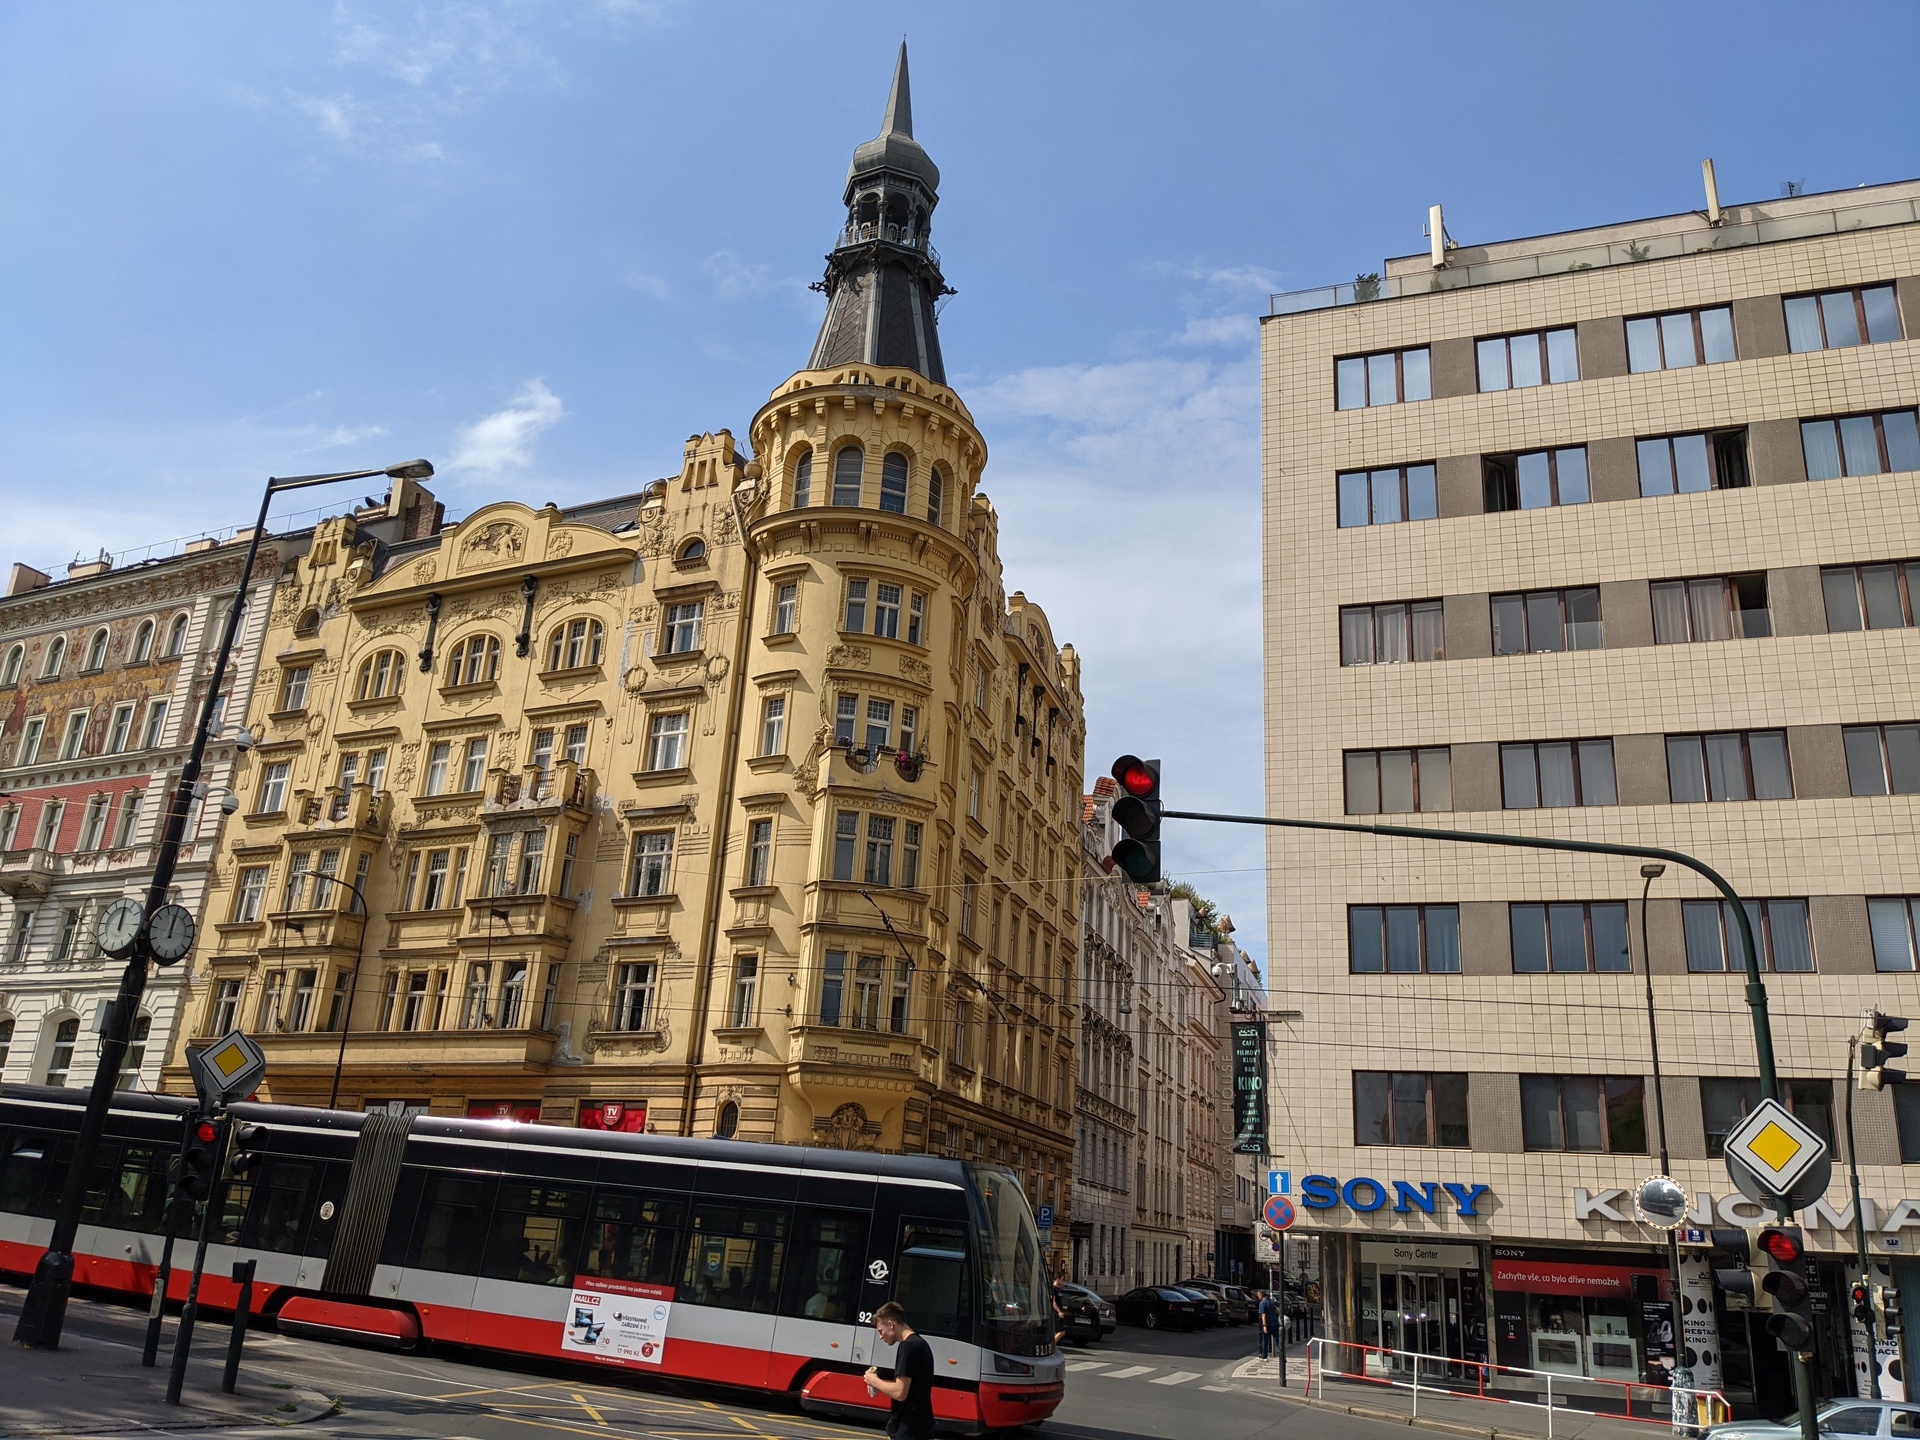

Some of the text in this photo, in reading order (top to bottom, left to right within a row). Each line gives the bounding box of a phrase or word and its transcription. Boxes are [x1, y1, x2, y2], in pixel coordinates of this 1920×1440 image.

[1222, 1054, 1234, 1112] HOUSE
[1238, 1076, 1263, 1090] KINO
[607, 1107, 617, 1115] TV
[1222, 1123, 1234, 1198] MOSAIC
[1301, 1174, 1489, 1216] SONY
[1573, 1187, 1777, 1228] KNO
[1394, 1248, 1438, 1260] Sony Center
[1495, 1249, 1526, 1257] SONY
[1528, 1273, 1541, 1282] vše,
[1551, 1275, 1567, 1284] bylo
[1568, 1275, 1586, 1284] dříve
[1587, 1277, 1620, 1286] nemožné
